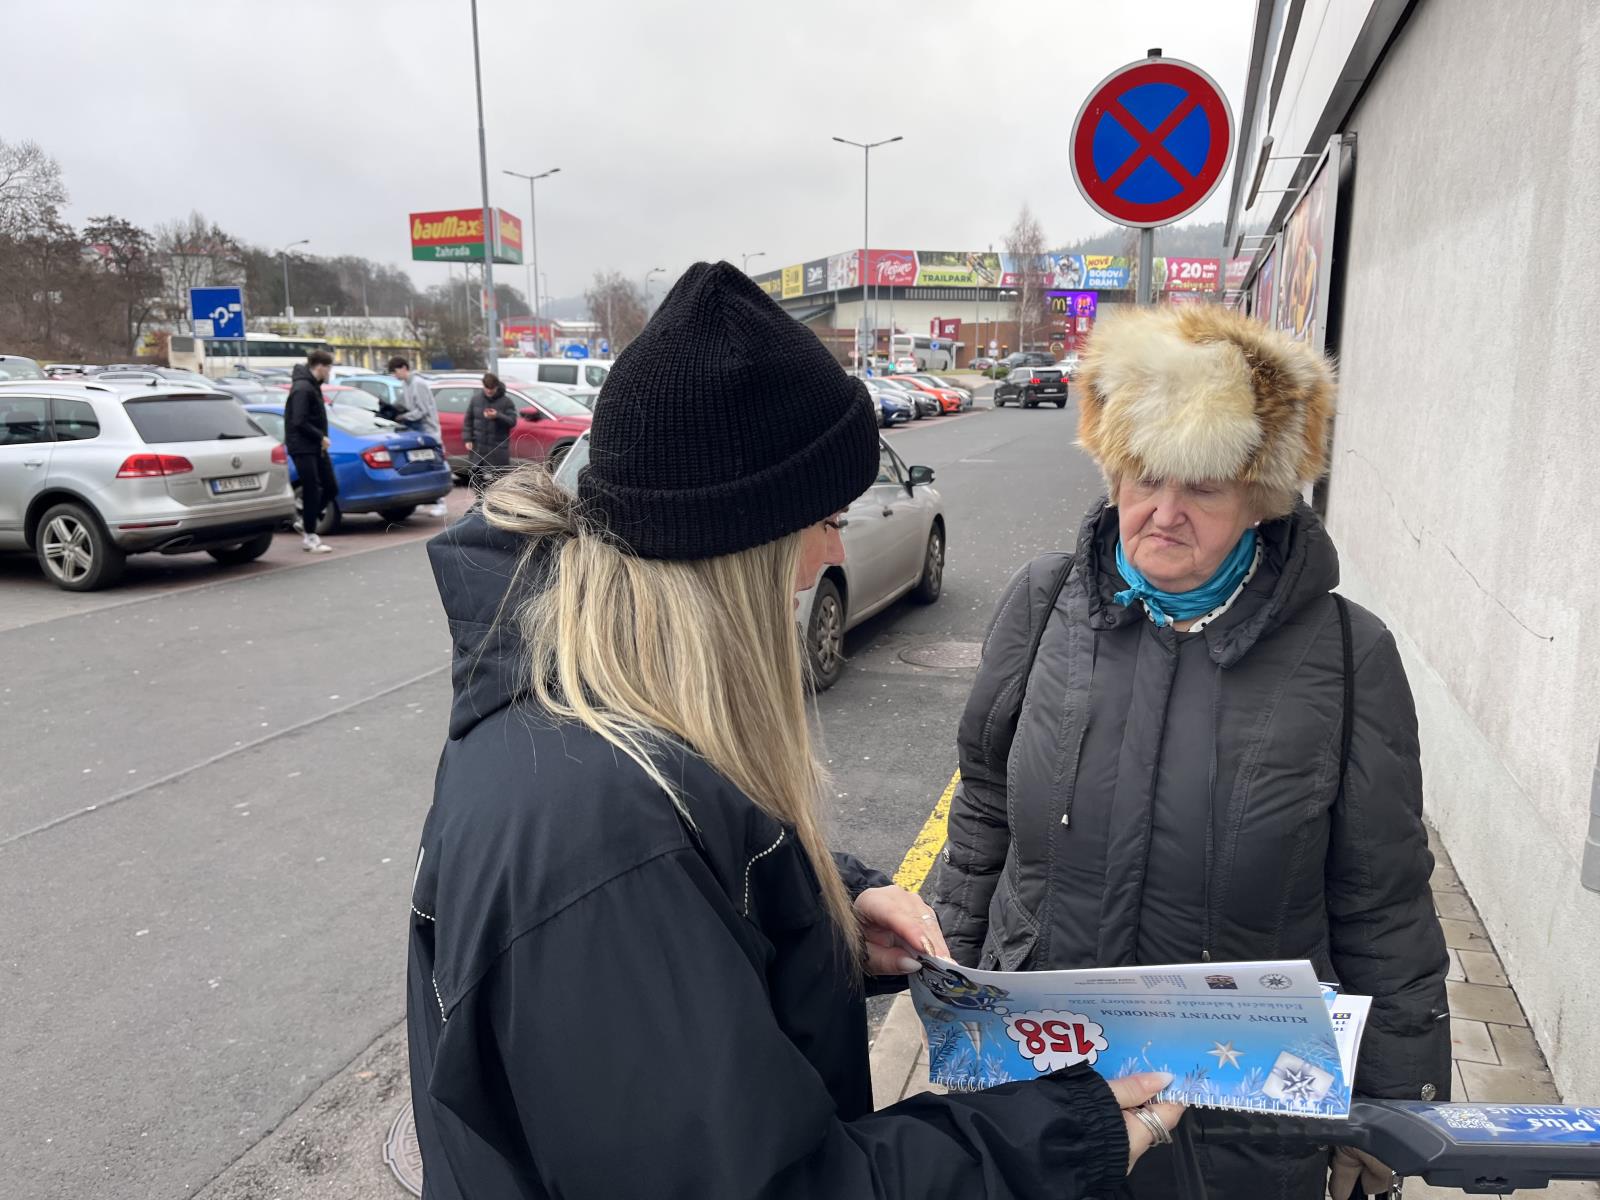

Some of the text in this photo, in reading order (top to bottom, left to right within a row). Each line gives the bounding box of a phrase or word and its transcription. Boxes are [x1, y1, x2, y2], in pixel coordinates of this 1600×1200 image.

[435, 246, 471, 257] Zahrada
[1180, 262, 1202, 279] 20
[1202, 263, 1217, 272] min
[1089, 268, 1124, 278] BOBOVÁ
[1202, 271, 1215, 279] km
[922, 274, 973, 283] TRAILPARK
[1101, 998, 1147, 1006] seniory
[1237, 1002, 1303, 1011] Edukační
[1100, 1009, 1308, 1024] KLIDNÝ ADVENT SENIORŮM
[1014, 1018, 1095, 1056] 158
[1485, 1106, 1568, 1117] minus
[1526, 1117, 1595, 1133] Plus
